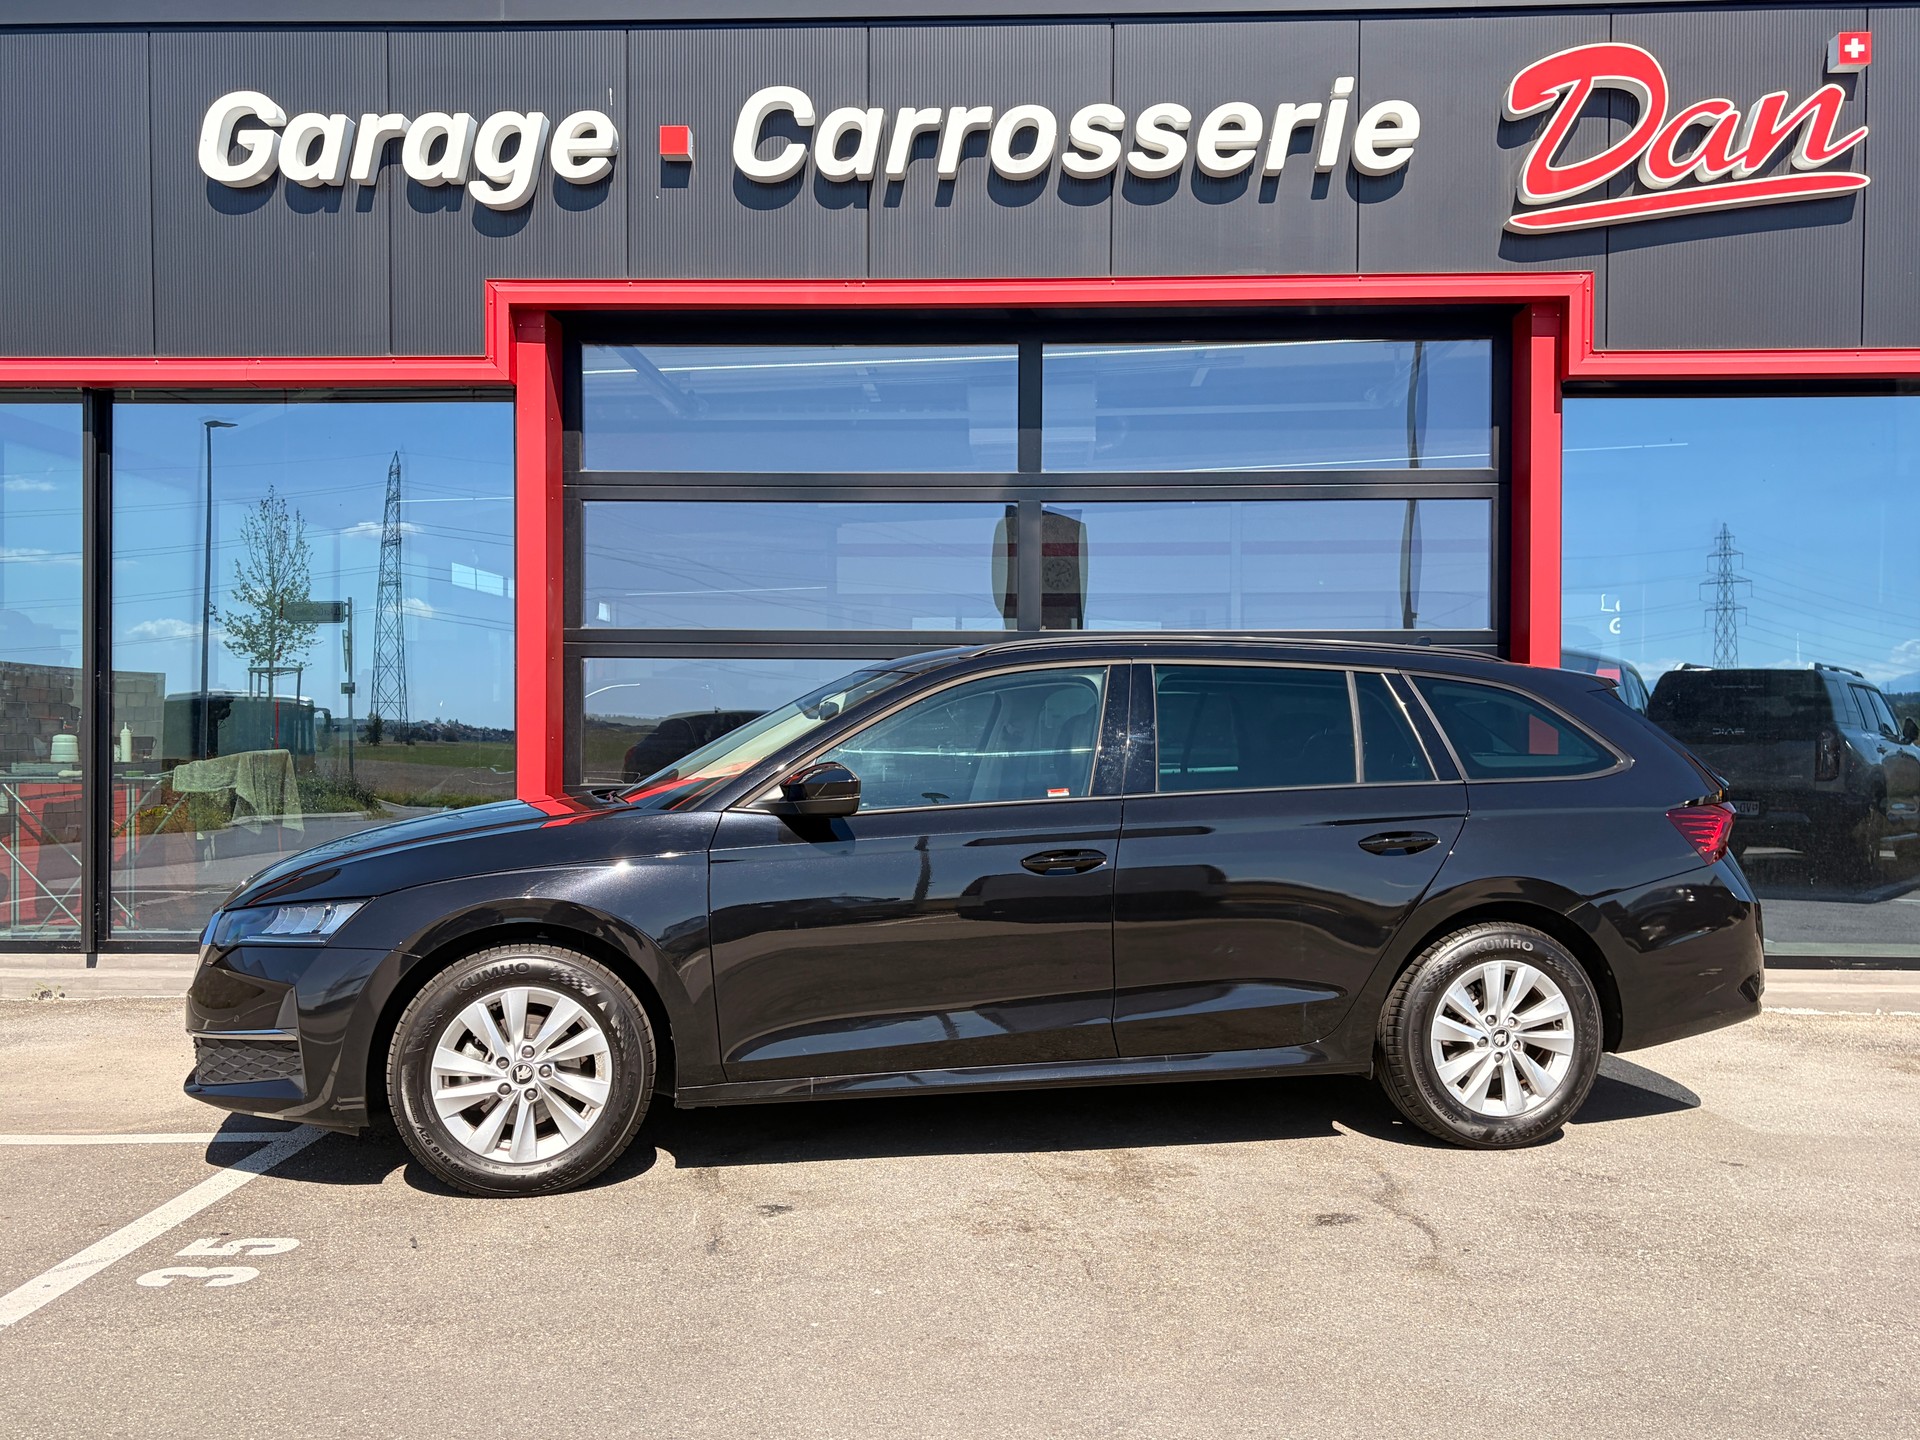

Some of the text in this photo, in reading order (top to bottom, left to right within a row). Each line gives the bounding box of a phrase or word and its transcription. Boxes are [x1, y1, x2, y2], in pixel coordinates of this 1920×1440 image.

[199, 90, 619, 211] Garage
[732, 76, 1421, 184] Carrosserie
[1474, 938, 1534, 955] KUMHO
[454, 962, 531, 995] KUMHO
[416, 1126, 434, 1146] 92V
[431, 1145, 452, 1163] R16
[136, 1237, 301, 1287] 35
